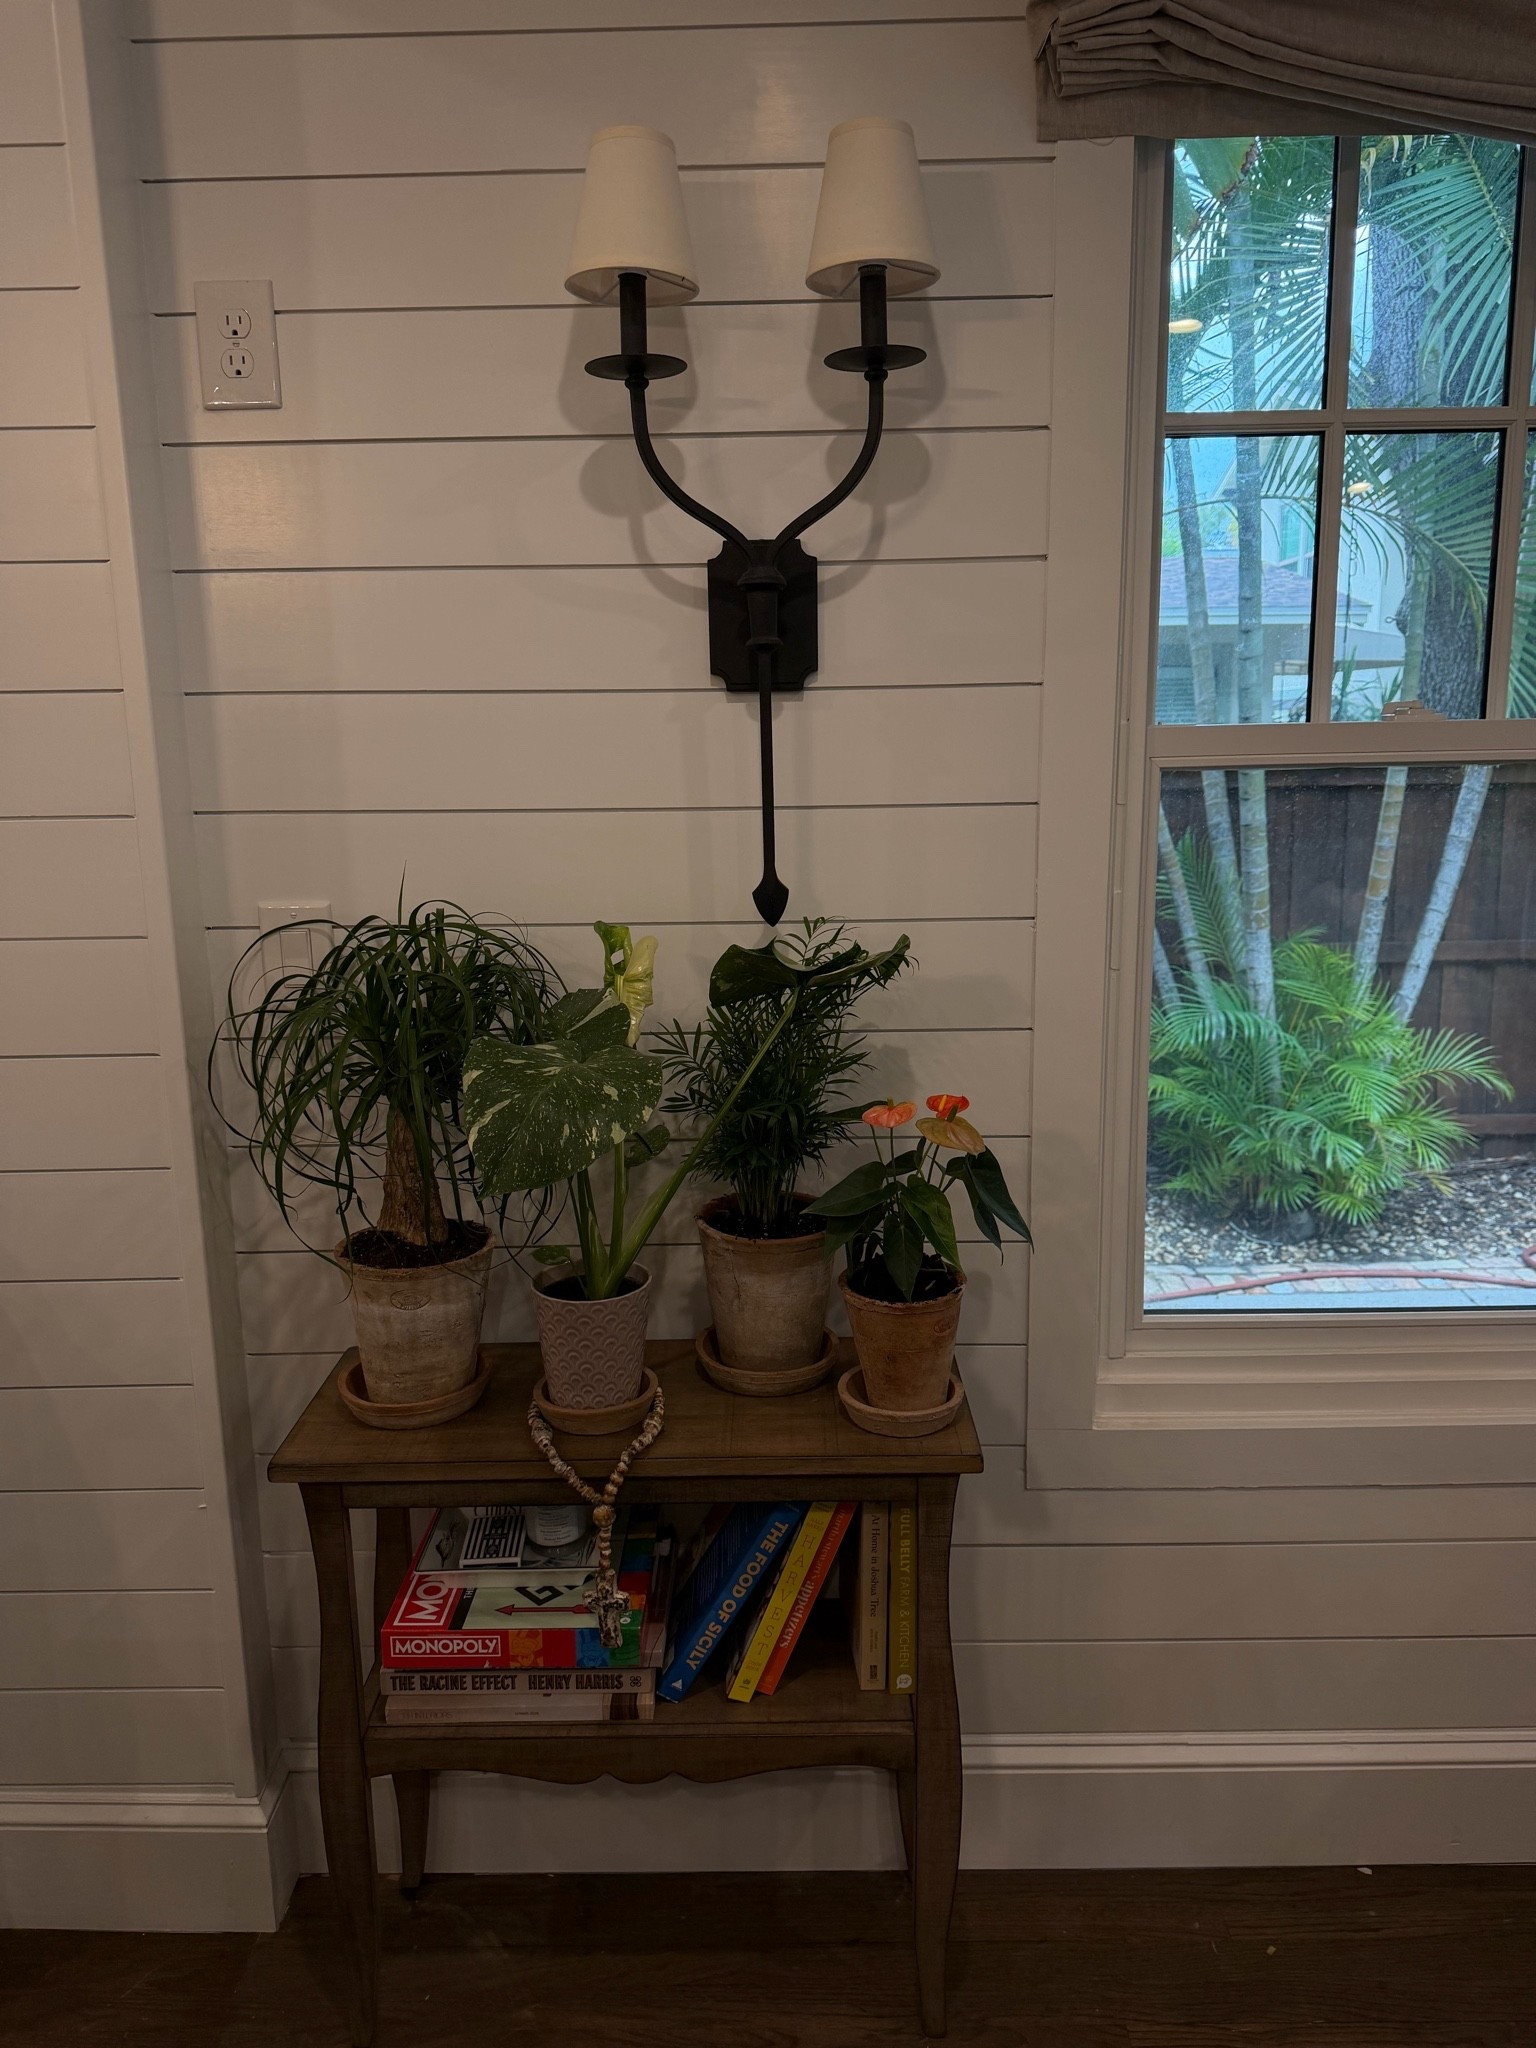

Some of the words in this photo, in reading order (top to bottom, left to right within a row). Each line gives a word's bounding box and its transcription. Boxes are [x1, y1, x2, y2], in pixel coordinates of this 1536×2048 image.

[871, 1514, 881, 1525] At
[900, 1508, 911, 1536] FULL
[760, 1521, 789, 1553] THE
[871, 1529, 880, 1553] Home
[871, 1556, 878, 1564] in
[900, 1540, 911, 1573] BELLY
[731, 1551, 768, 1598] FOOD
[871, 1567, 880, 1596] Joshua
[757, 1534, 816, 1656] HARVEST
[900, 1577, 910, 1607] FARM
[718, 1598, 737, 1623] OF
[779, 1580, 814, 1649] appetizers
[870, 1597, 880, 1618] Tree
[395, 1639, 497, 1654] MONOPOLY
[686, 1622, 723, 1671] SICILY
[899, 1622, 910, 1668] KITCHEN
[390, 1675, 416, 1691] THE
[420, 1675, 467, 1691] RACINE
[471, 1674, 517, 1690] EFFECT
[528, 1674, 571, 1690] HENRY
[575, 1673, 624, 1690] HARRIS
